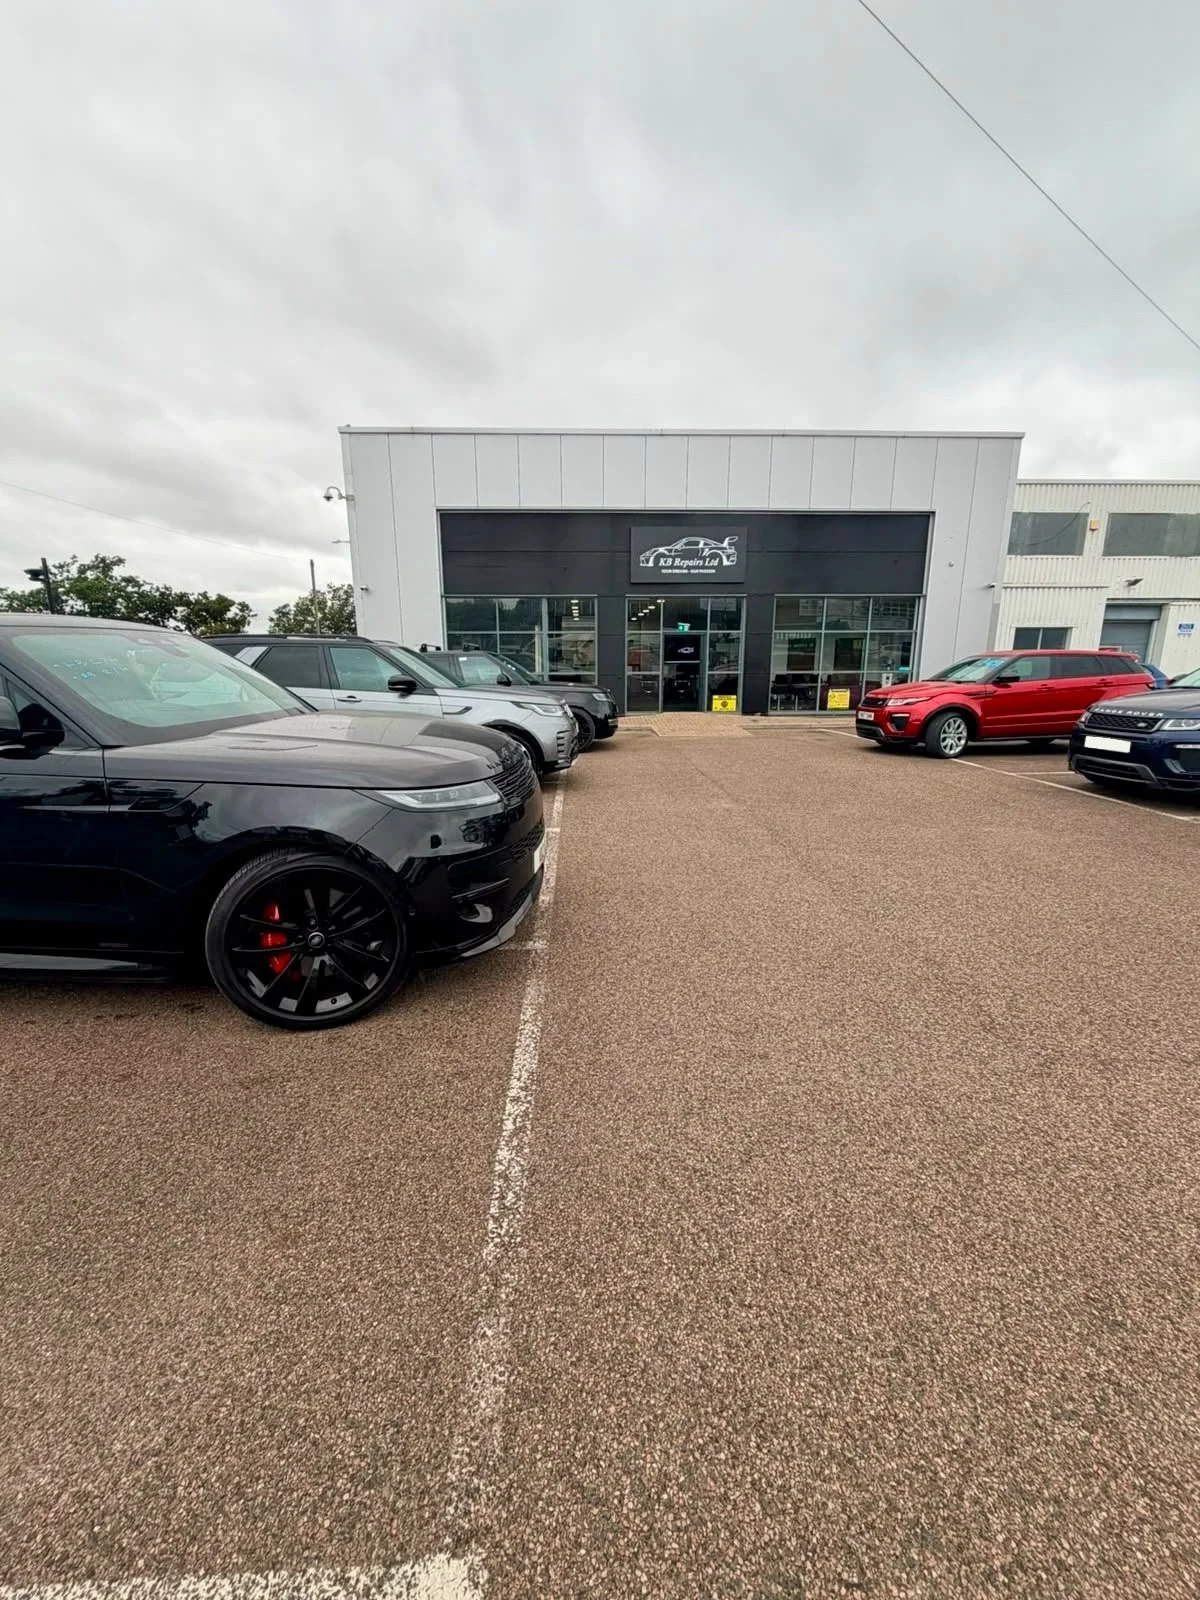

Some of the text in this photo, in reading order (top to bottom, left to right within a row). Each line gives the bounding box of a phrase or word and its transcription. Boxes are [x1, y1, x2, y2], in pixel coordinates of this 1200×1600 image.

[659, 557, 719, 568] KB Repairs Ltd
